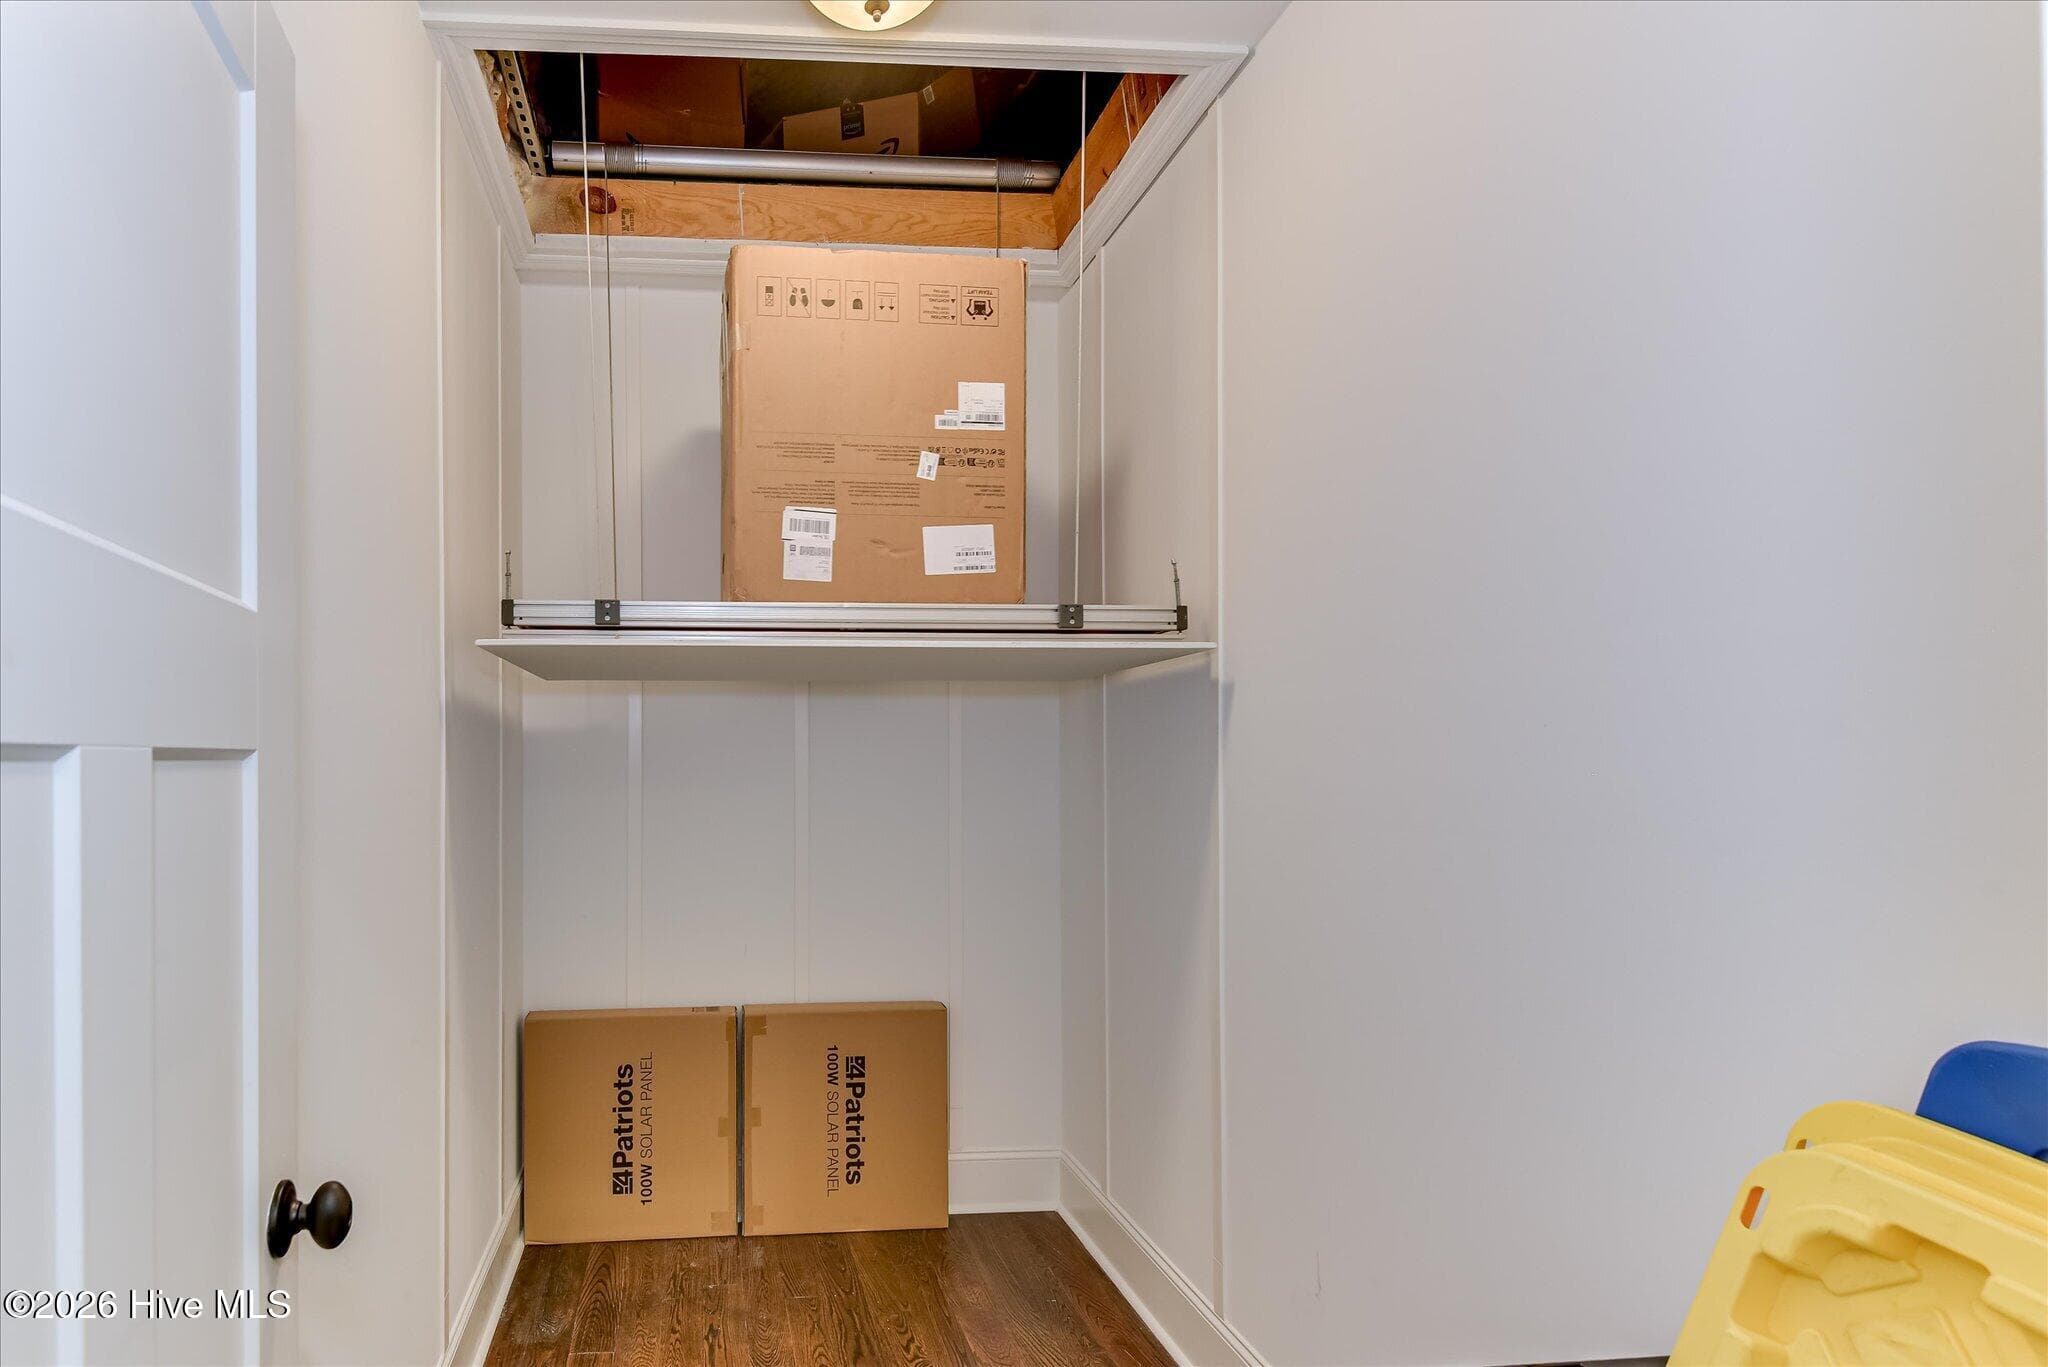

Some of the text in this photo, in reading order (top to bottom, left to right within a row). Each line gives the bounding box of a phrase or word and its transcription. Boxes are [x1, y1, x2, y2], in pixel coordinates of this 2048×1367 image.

[612, 1063, 635, 1195] 4Patriots
[640, 1051, 653, 1206] 100W SOLAR PANEL
[826, 1044, 840, 1197] 100W SOLAR PANEL
[845, 1055, 866, 1185] 4Patriots
